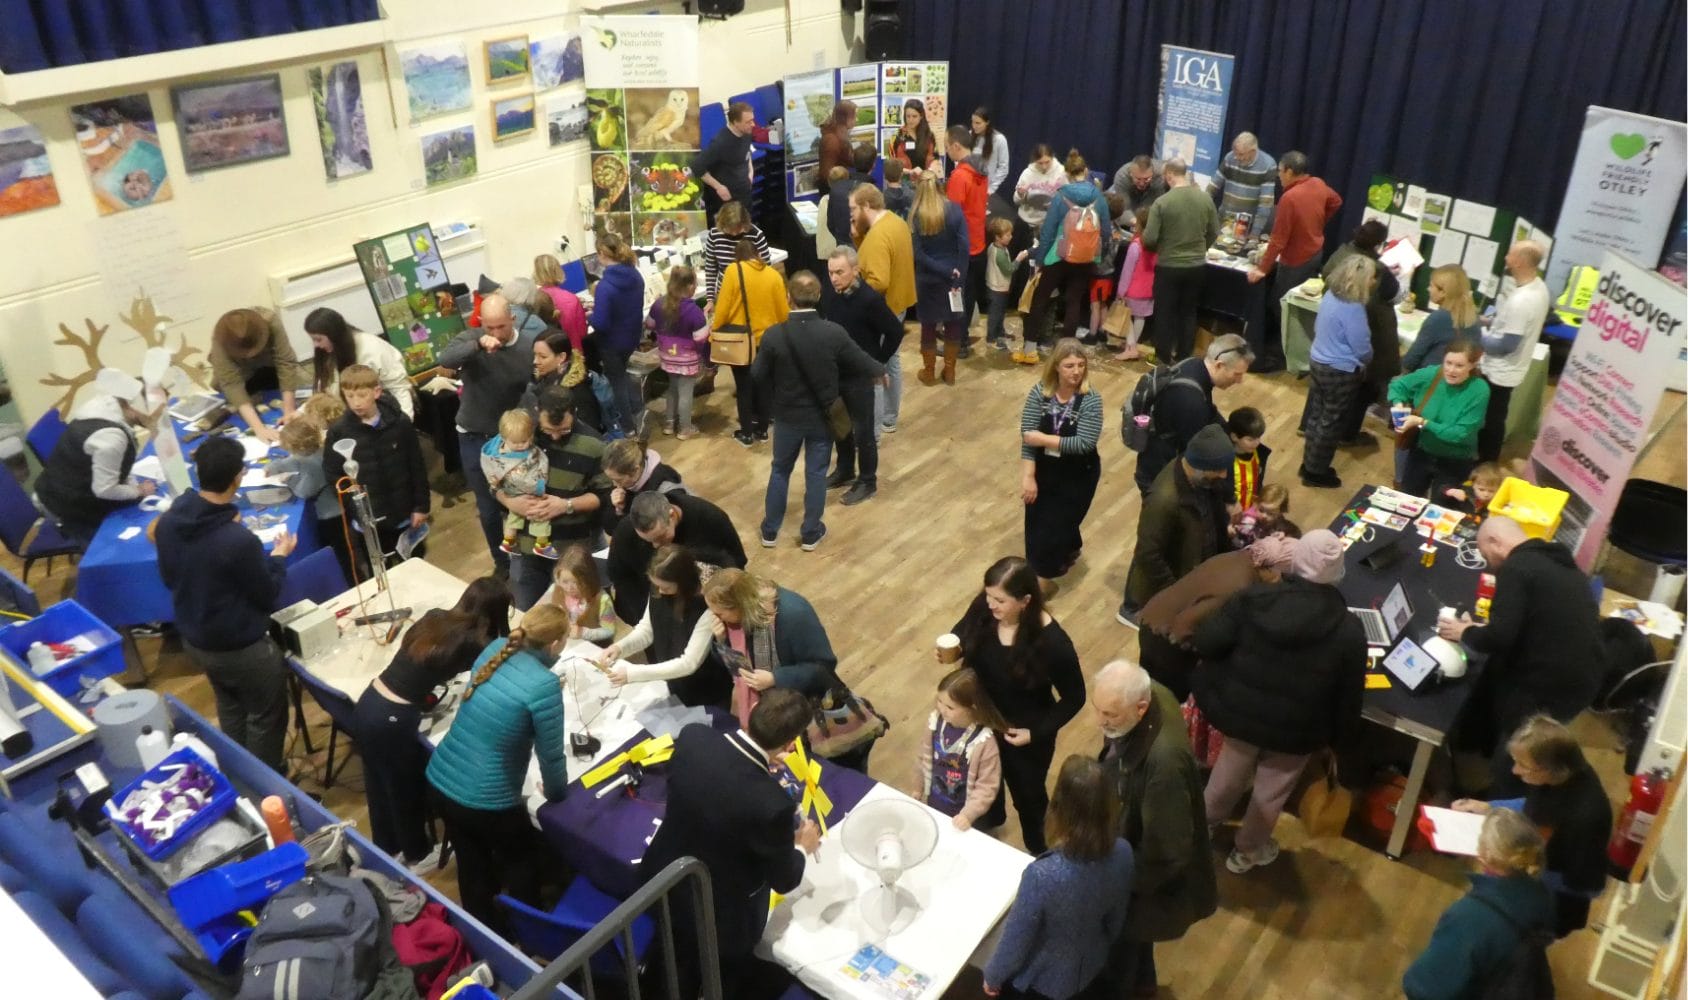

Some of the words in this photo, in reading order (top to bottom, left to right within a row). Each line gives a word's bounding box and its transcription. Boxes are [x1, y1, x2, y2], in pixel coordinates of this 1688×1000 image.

[1173, 54, 1223, 92] LGA
[1599, 180, 1648, 197] OTLEY
[1602, 171, 1649, 184] FRIENDLY
[1606, 163, 1652, 178] WILDLIFE
[1599, 271, 1682, 336] discover
[1587, 299, 1650, 353] digital
[1562, 438, 1610, 485] discover
